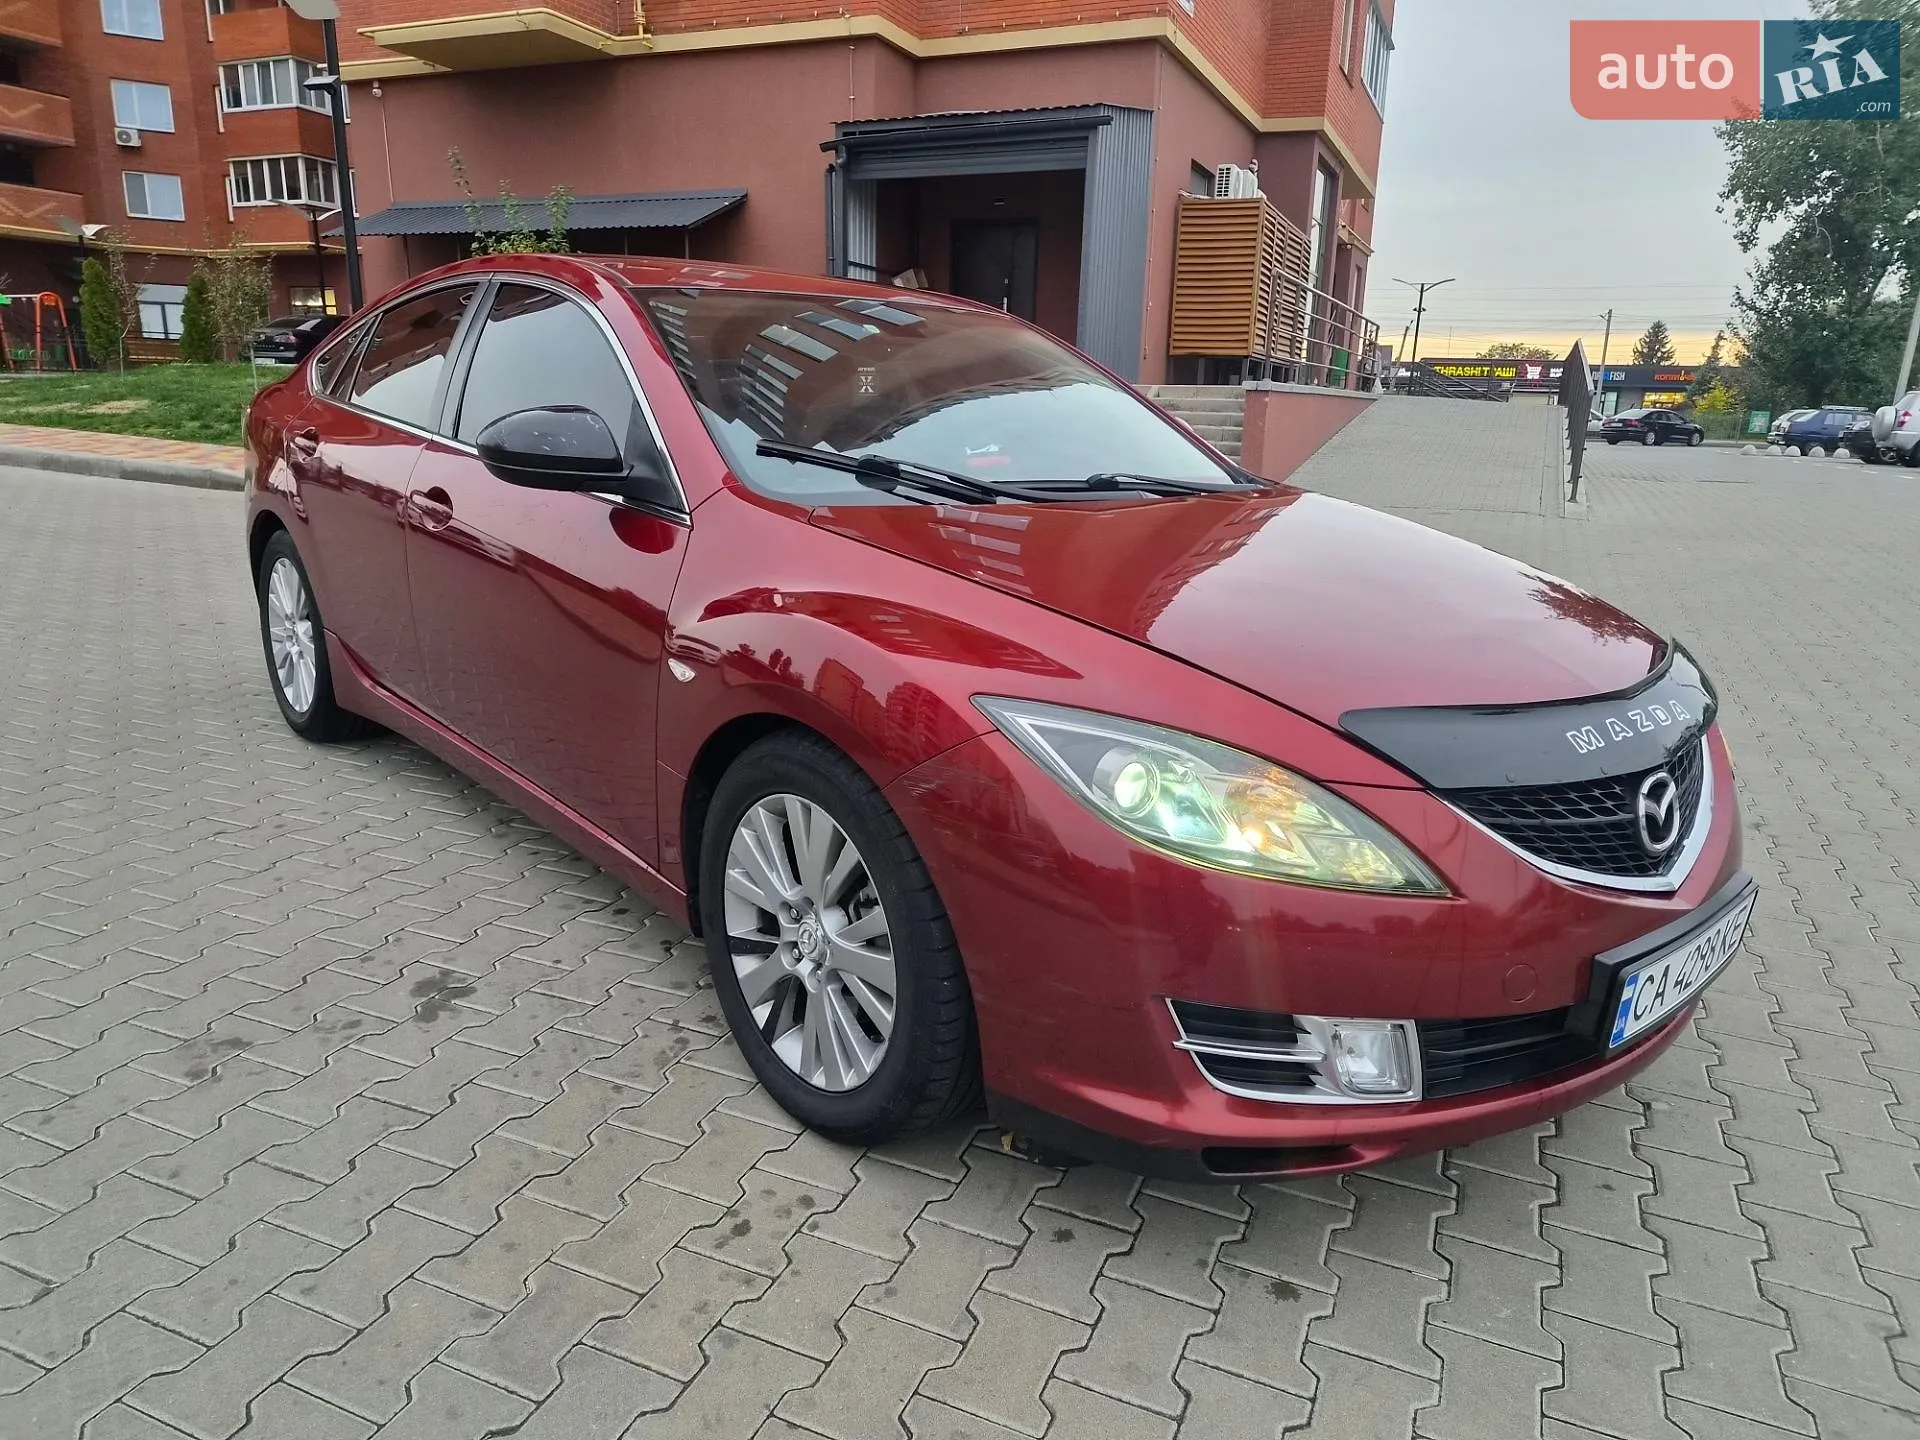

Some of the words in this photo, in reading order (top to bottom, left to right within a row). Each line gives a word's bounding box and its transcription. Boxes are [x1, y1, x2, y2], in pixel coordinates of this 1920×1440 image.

[1566, 700, 1691, 754] MAZDA
[1633, 963, 1671, 1022] CA
[1673, 928, 1722, 995] 4298
